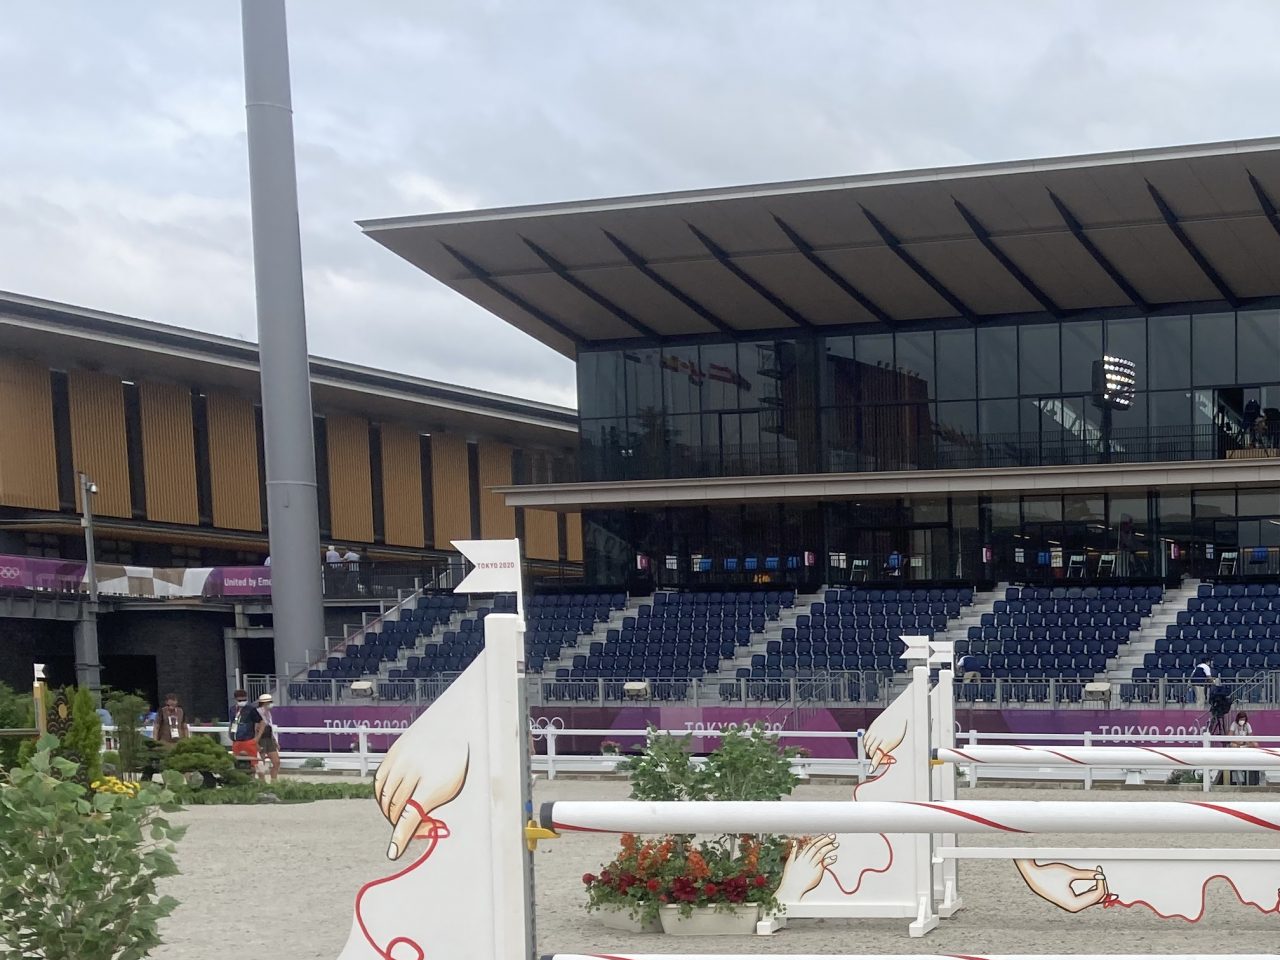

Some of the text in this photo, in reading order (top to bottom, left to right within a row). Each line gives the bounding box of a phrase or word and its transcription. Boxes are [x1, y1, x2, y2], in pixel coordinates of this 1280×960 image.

[499, 561, 515, 569] 2020
[224, 577, 247, 587] United
[249, 577, 256, 588] by
[324, 719, 370, 736] TOKYO
[1099, 725, 1160, 744] TOKYO
